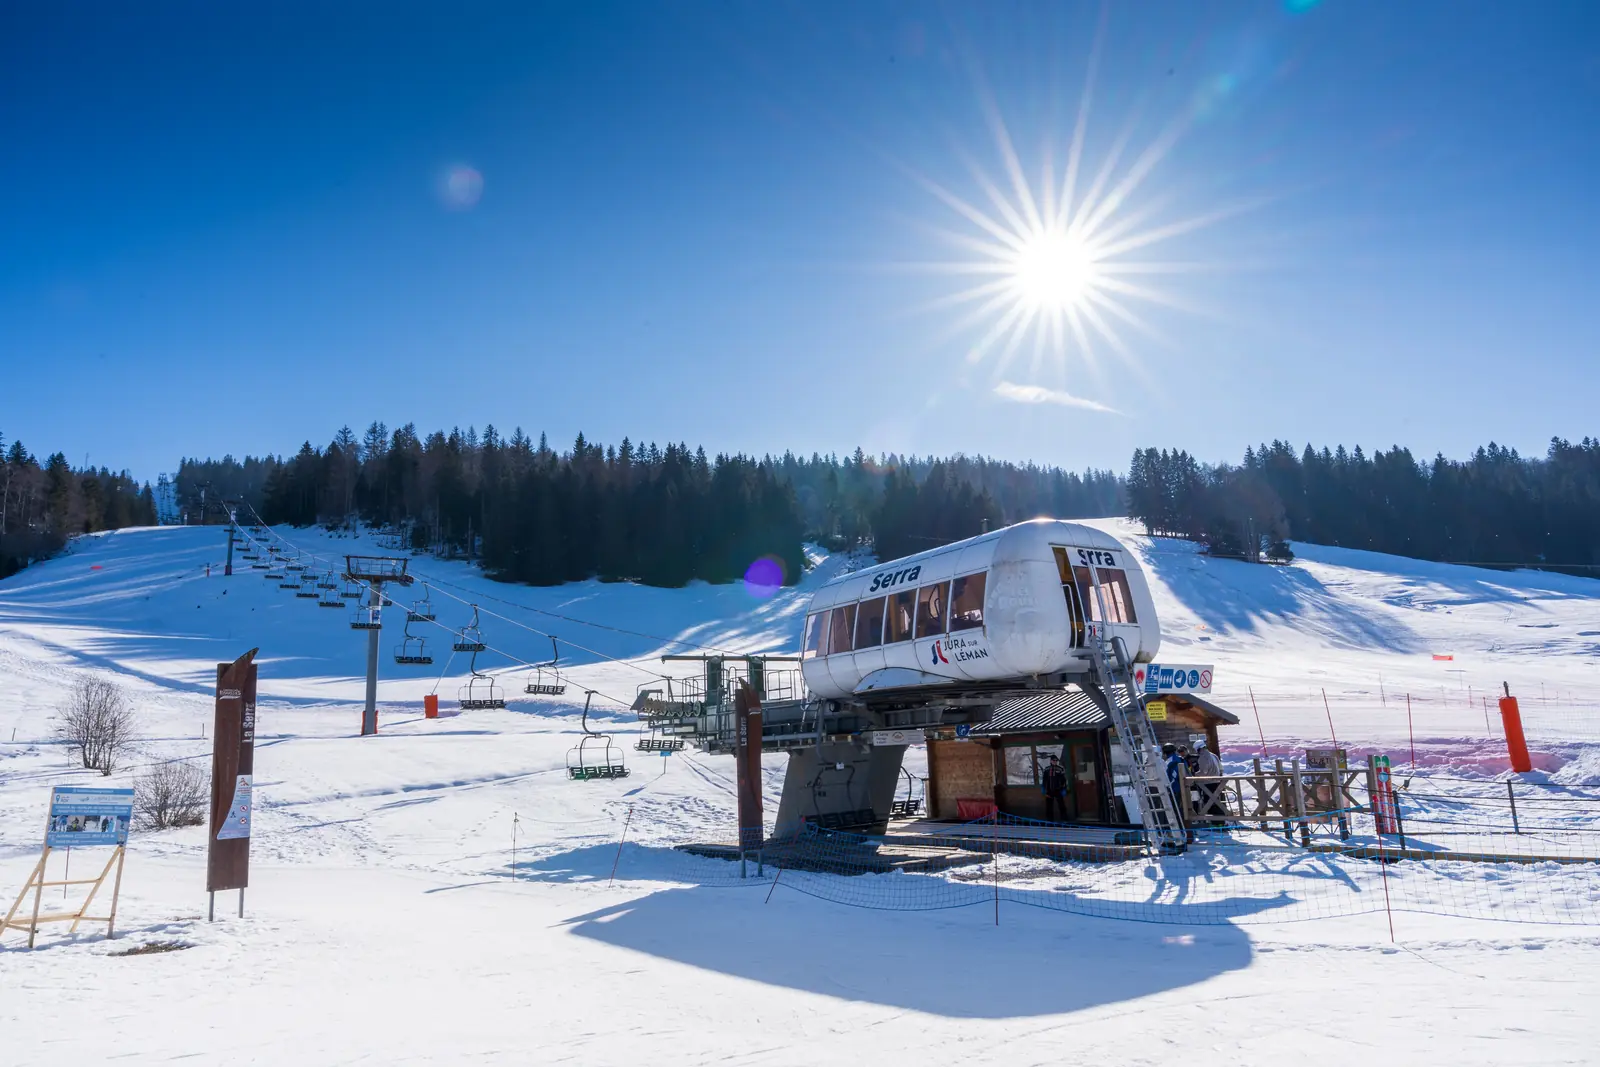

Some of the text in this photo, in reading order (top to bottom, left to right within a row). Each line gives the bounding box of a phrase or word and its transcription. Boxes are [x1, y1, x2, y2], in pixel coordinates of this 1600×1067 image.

[869, 565, 922, 593] Serra
[944, 638, 979, 651] JURA SUR
[954, 648, 989, 662] LÉMAN
